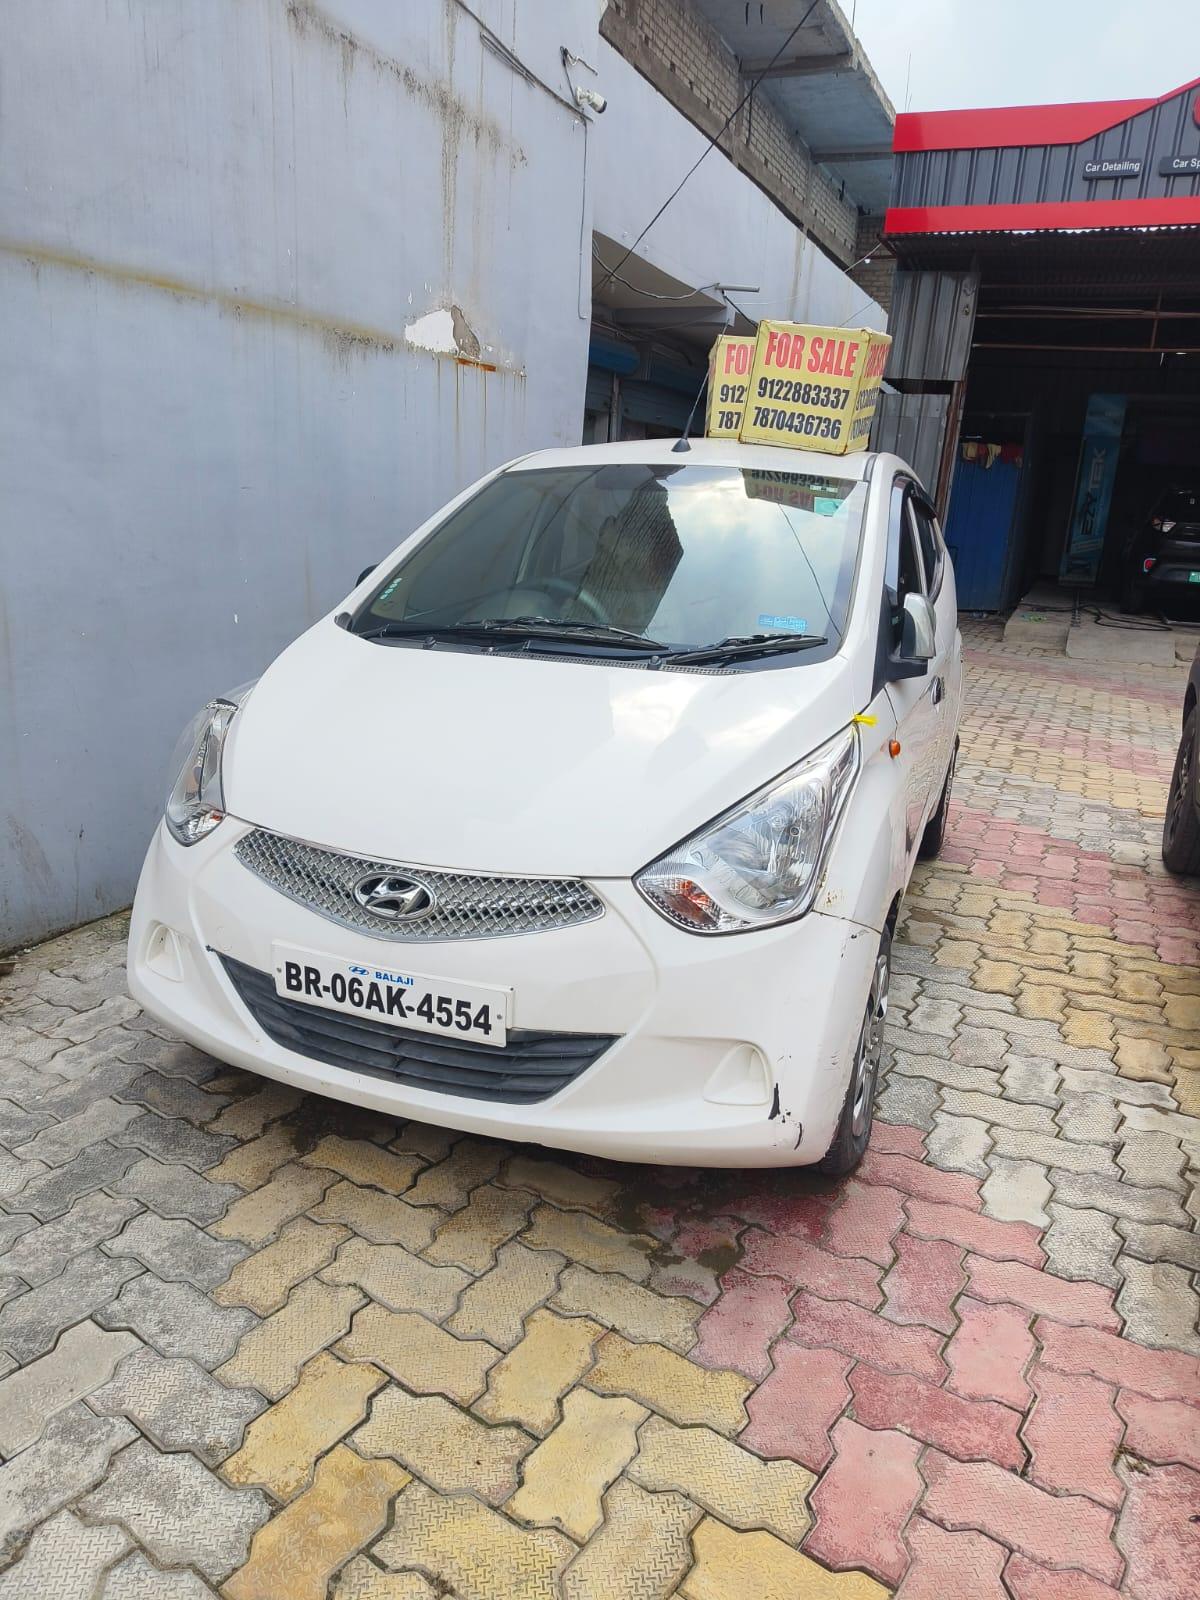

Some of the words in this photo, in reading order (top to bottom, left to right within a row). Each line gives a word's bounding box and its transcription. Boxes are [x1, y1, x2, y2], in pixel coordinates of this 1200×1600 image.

[1085, 163, 1101, 172] Car
[1102, 161, 1141, 172] Detailing
[1172, 159, 1189, 168] Car
[764, 331, 805, 370] FOR
[807, 336, 859, 378] SALE
[720, 384, 747, 404] 912
[757, 376, 850, 410] 9122883337
[752, 406, 842, 440] 7870436736
[375, 971, 414, 986] BALAJI
[285, 961, 492, 1035] BR-06AK-4554
